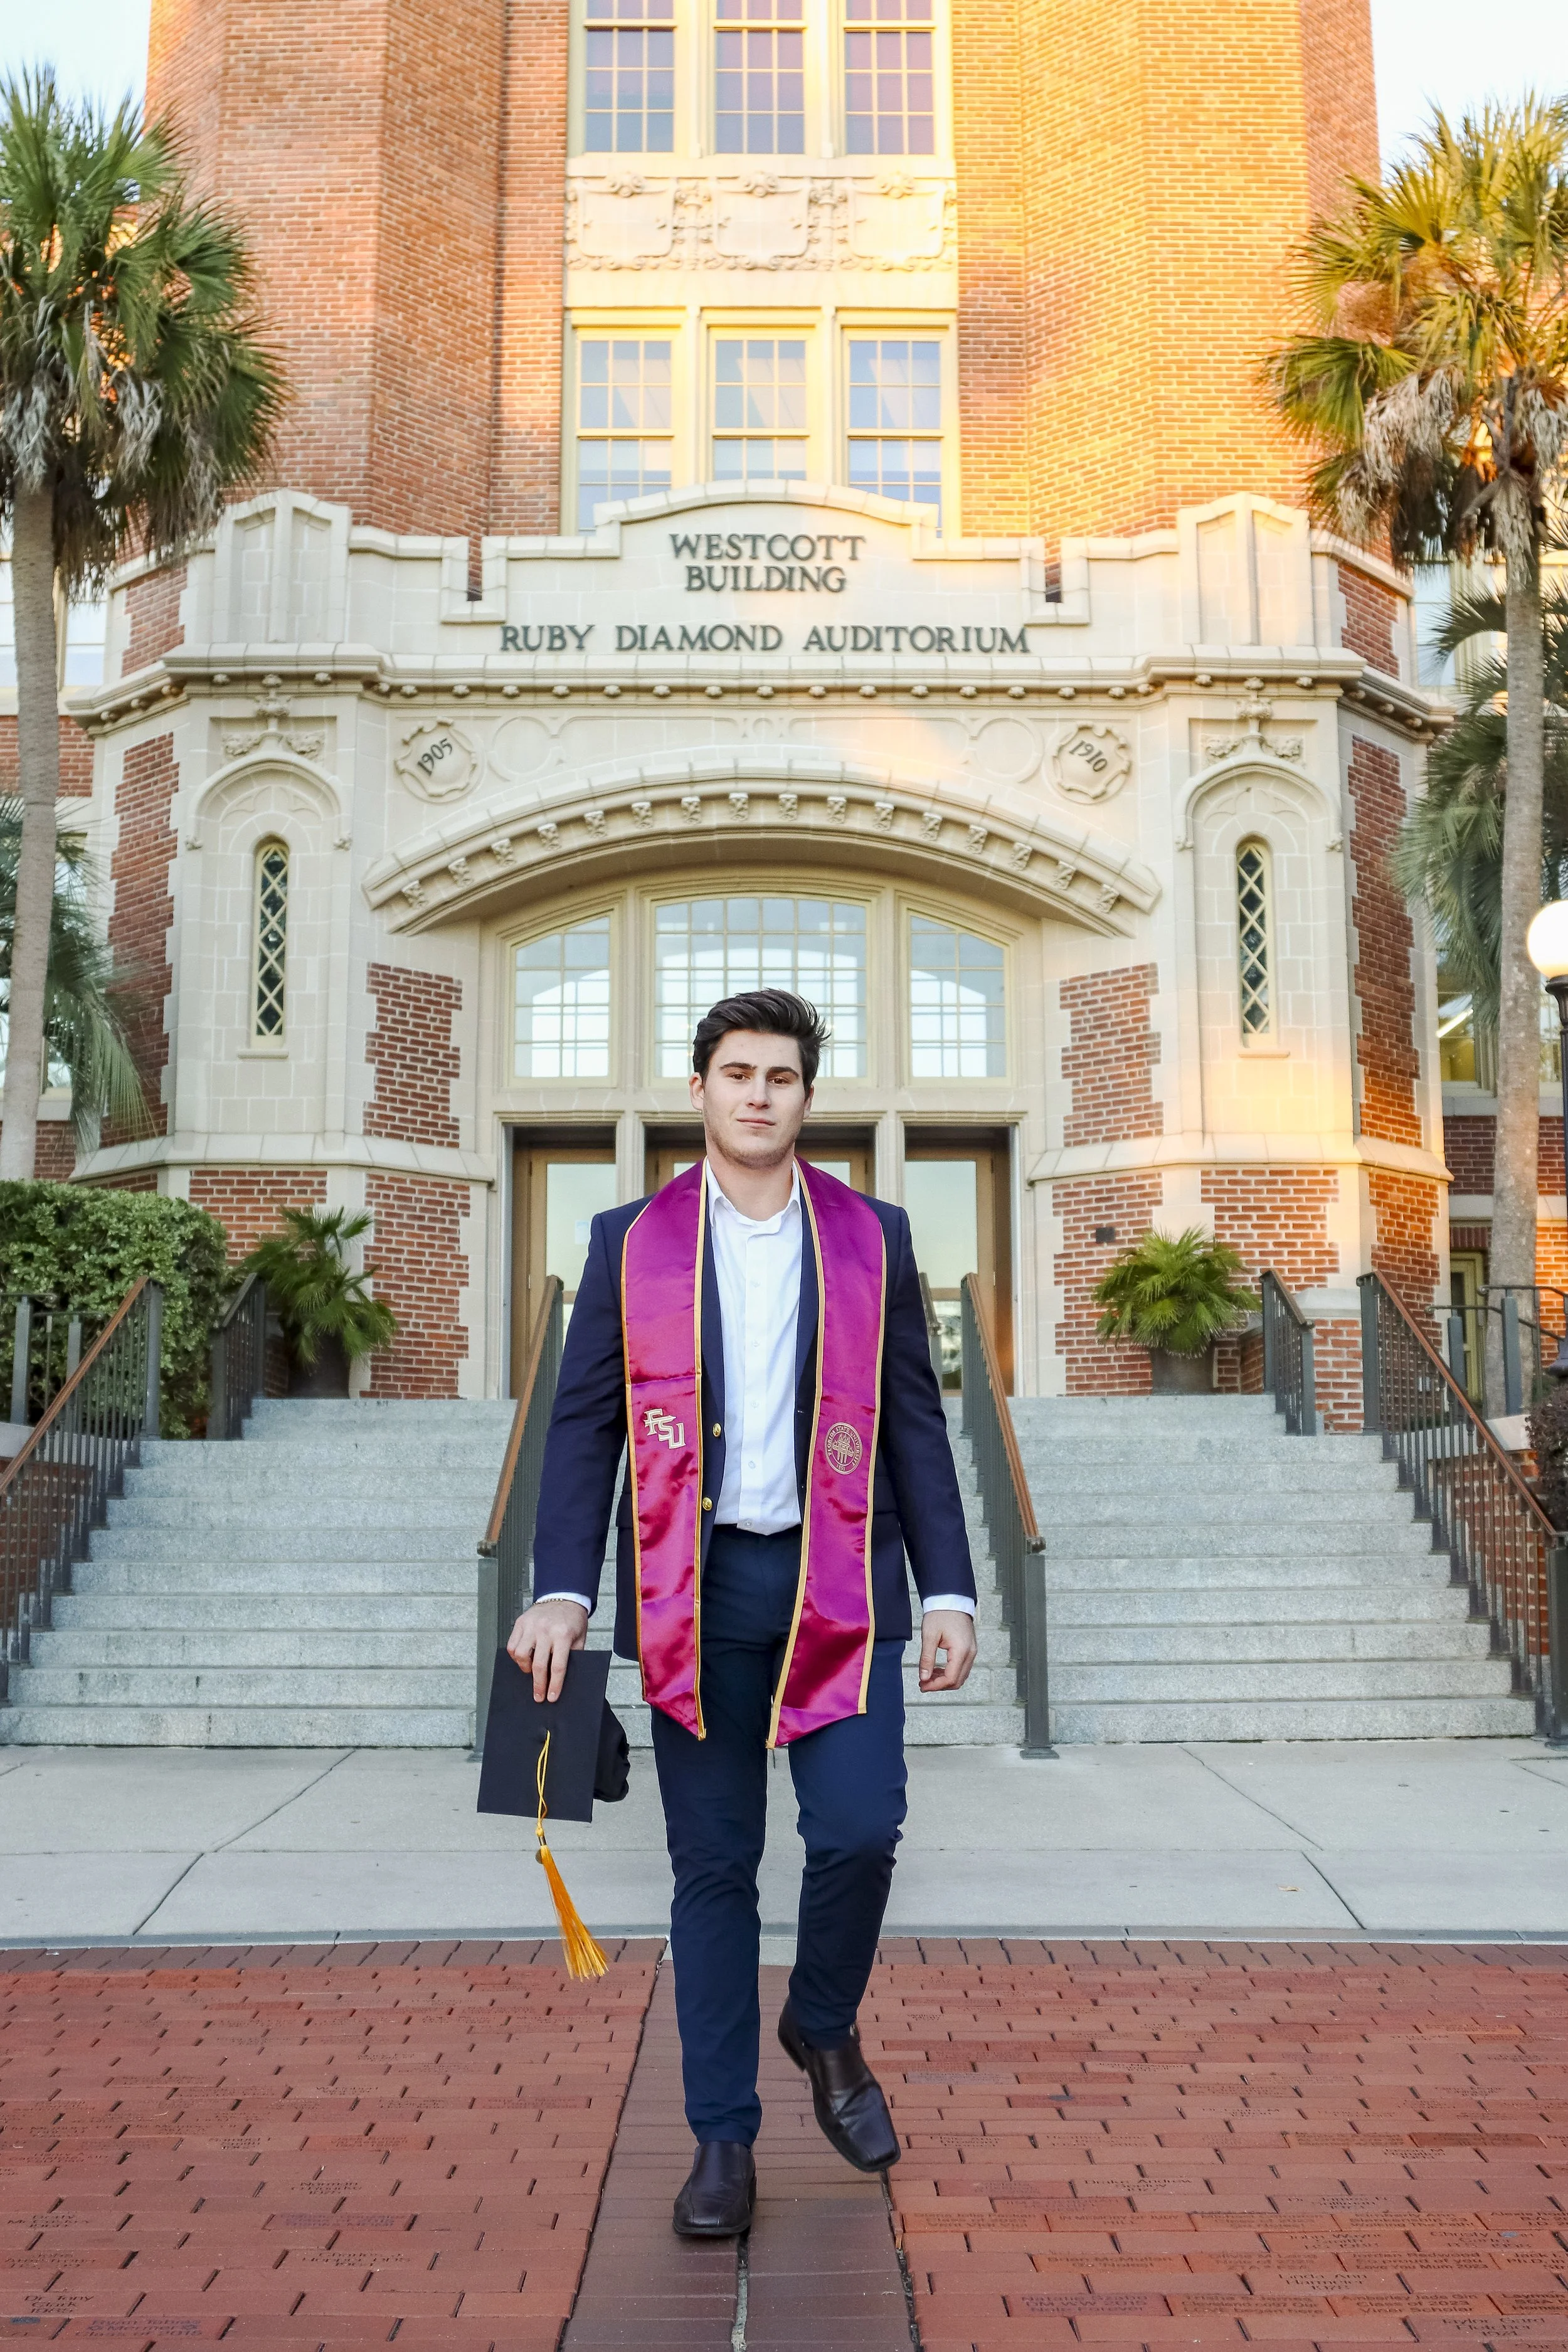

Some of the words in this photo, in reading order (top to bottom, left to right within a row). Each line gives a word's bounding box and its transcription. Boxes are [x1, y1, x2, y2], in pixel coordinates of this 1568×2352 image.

[669, 533, 866, 561] WESTCOTT
[685, 565, 847, 593] BUILDING
[501, 625, 595, 652] RUBY
[617, 625, 783, 652] DIAMOND
[804, 625, 1030, 654] AUDITORIUM
[417, 738, 453, 776] 1905
[1068, 740, 1108, 773] 1910
[644, 1407, 686, 1450] FSU
[827, 1430, 836, 1456] FLORIDA
[835, 1426, 850, 1434] STATE
[850, 1431, 861, 1466] UNIVERSITY
